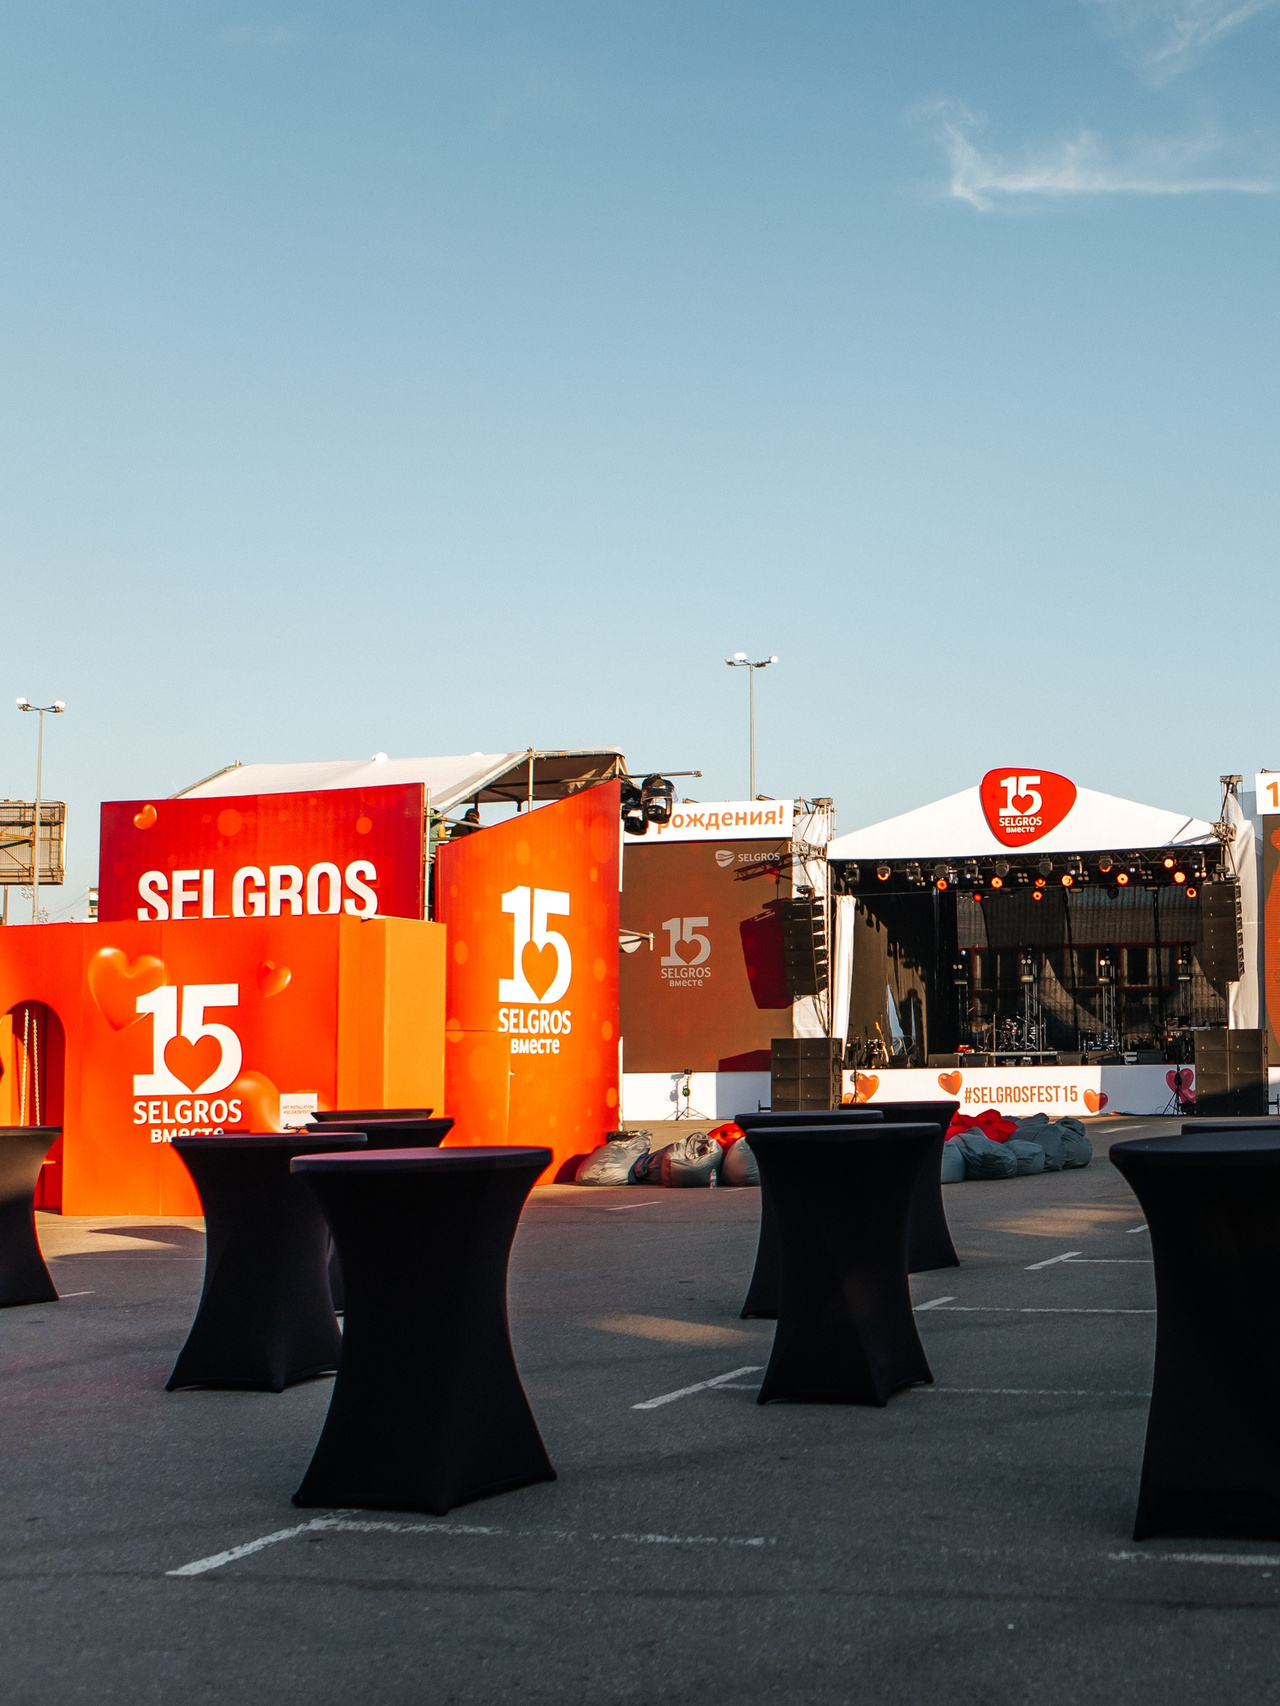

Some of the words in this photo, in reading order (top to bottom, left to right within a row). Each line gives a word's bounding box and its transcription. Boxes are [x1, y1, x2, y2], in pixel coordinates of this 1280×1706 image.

[999, 775, 1043, 816] 15
[998, 816, 1043, 827] SELGROS
[737, 852, 781, 863] SELGROS
[137, 859, 378, 921] SELGROS
[498, 885, 572, 1005] 15
[660, 916, 712, 967] 15
[660, 967, 712, 979] SELGROS
[498, 1007, 572, 1035] SELGROS
[133, 983, 243, 1096] 15
[510, 1038, 560, 1054] вместе
[964, 1085, 1079, 1104] #SELGROSFEST15
[133, 1099, 242, 1125] SELGROS
